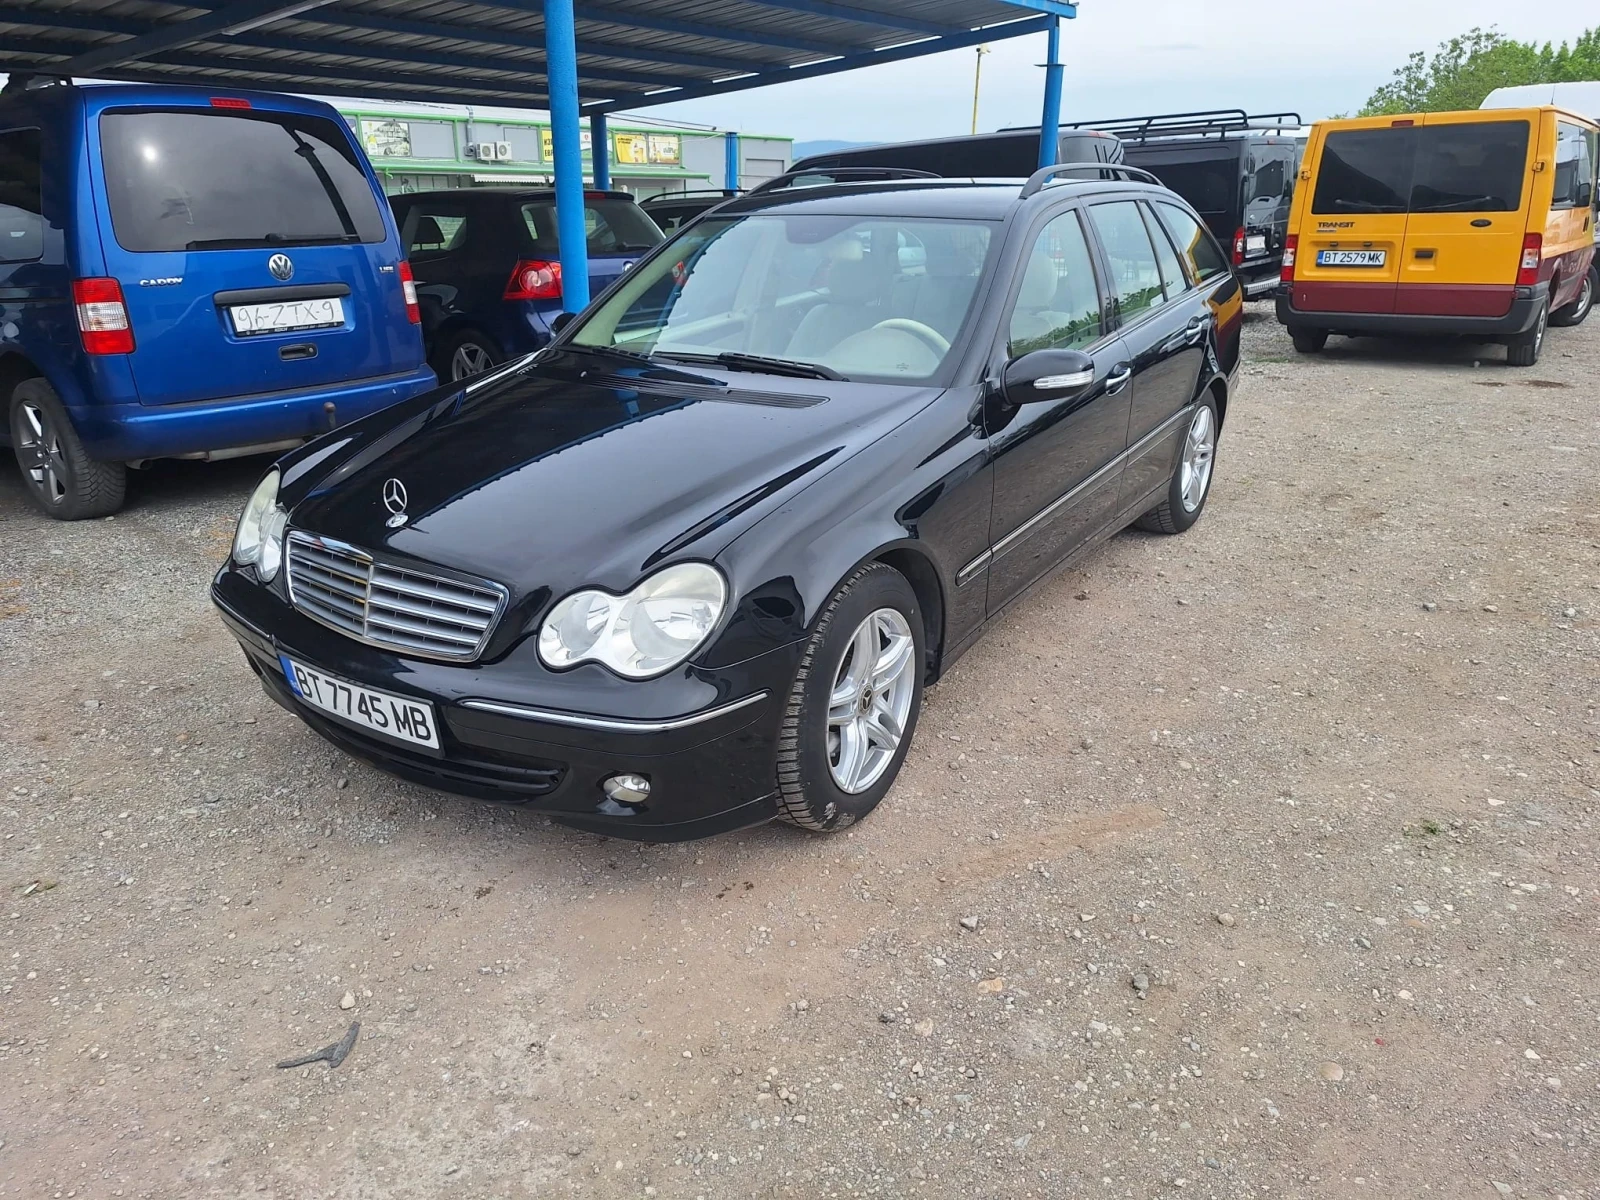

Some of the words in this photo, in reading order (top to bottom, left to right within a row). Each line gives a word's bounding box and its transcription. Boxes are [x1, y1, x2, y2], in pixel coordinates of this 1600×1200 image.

[1324, 252, 1339, 263] BT
[1340, 252, 1367, 263] 2579
[1367, 252, 1383, 263] MK
[140, 277, 183, 286] CADDY
[238, 301, 334, 331] 96-ZTX-9
[294, 666, 323, 704] BT
[324, 680, 389, 728] 7745
[390, 701, 432, 741] MB
